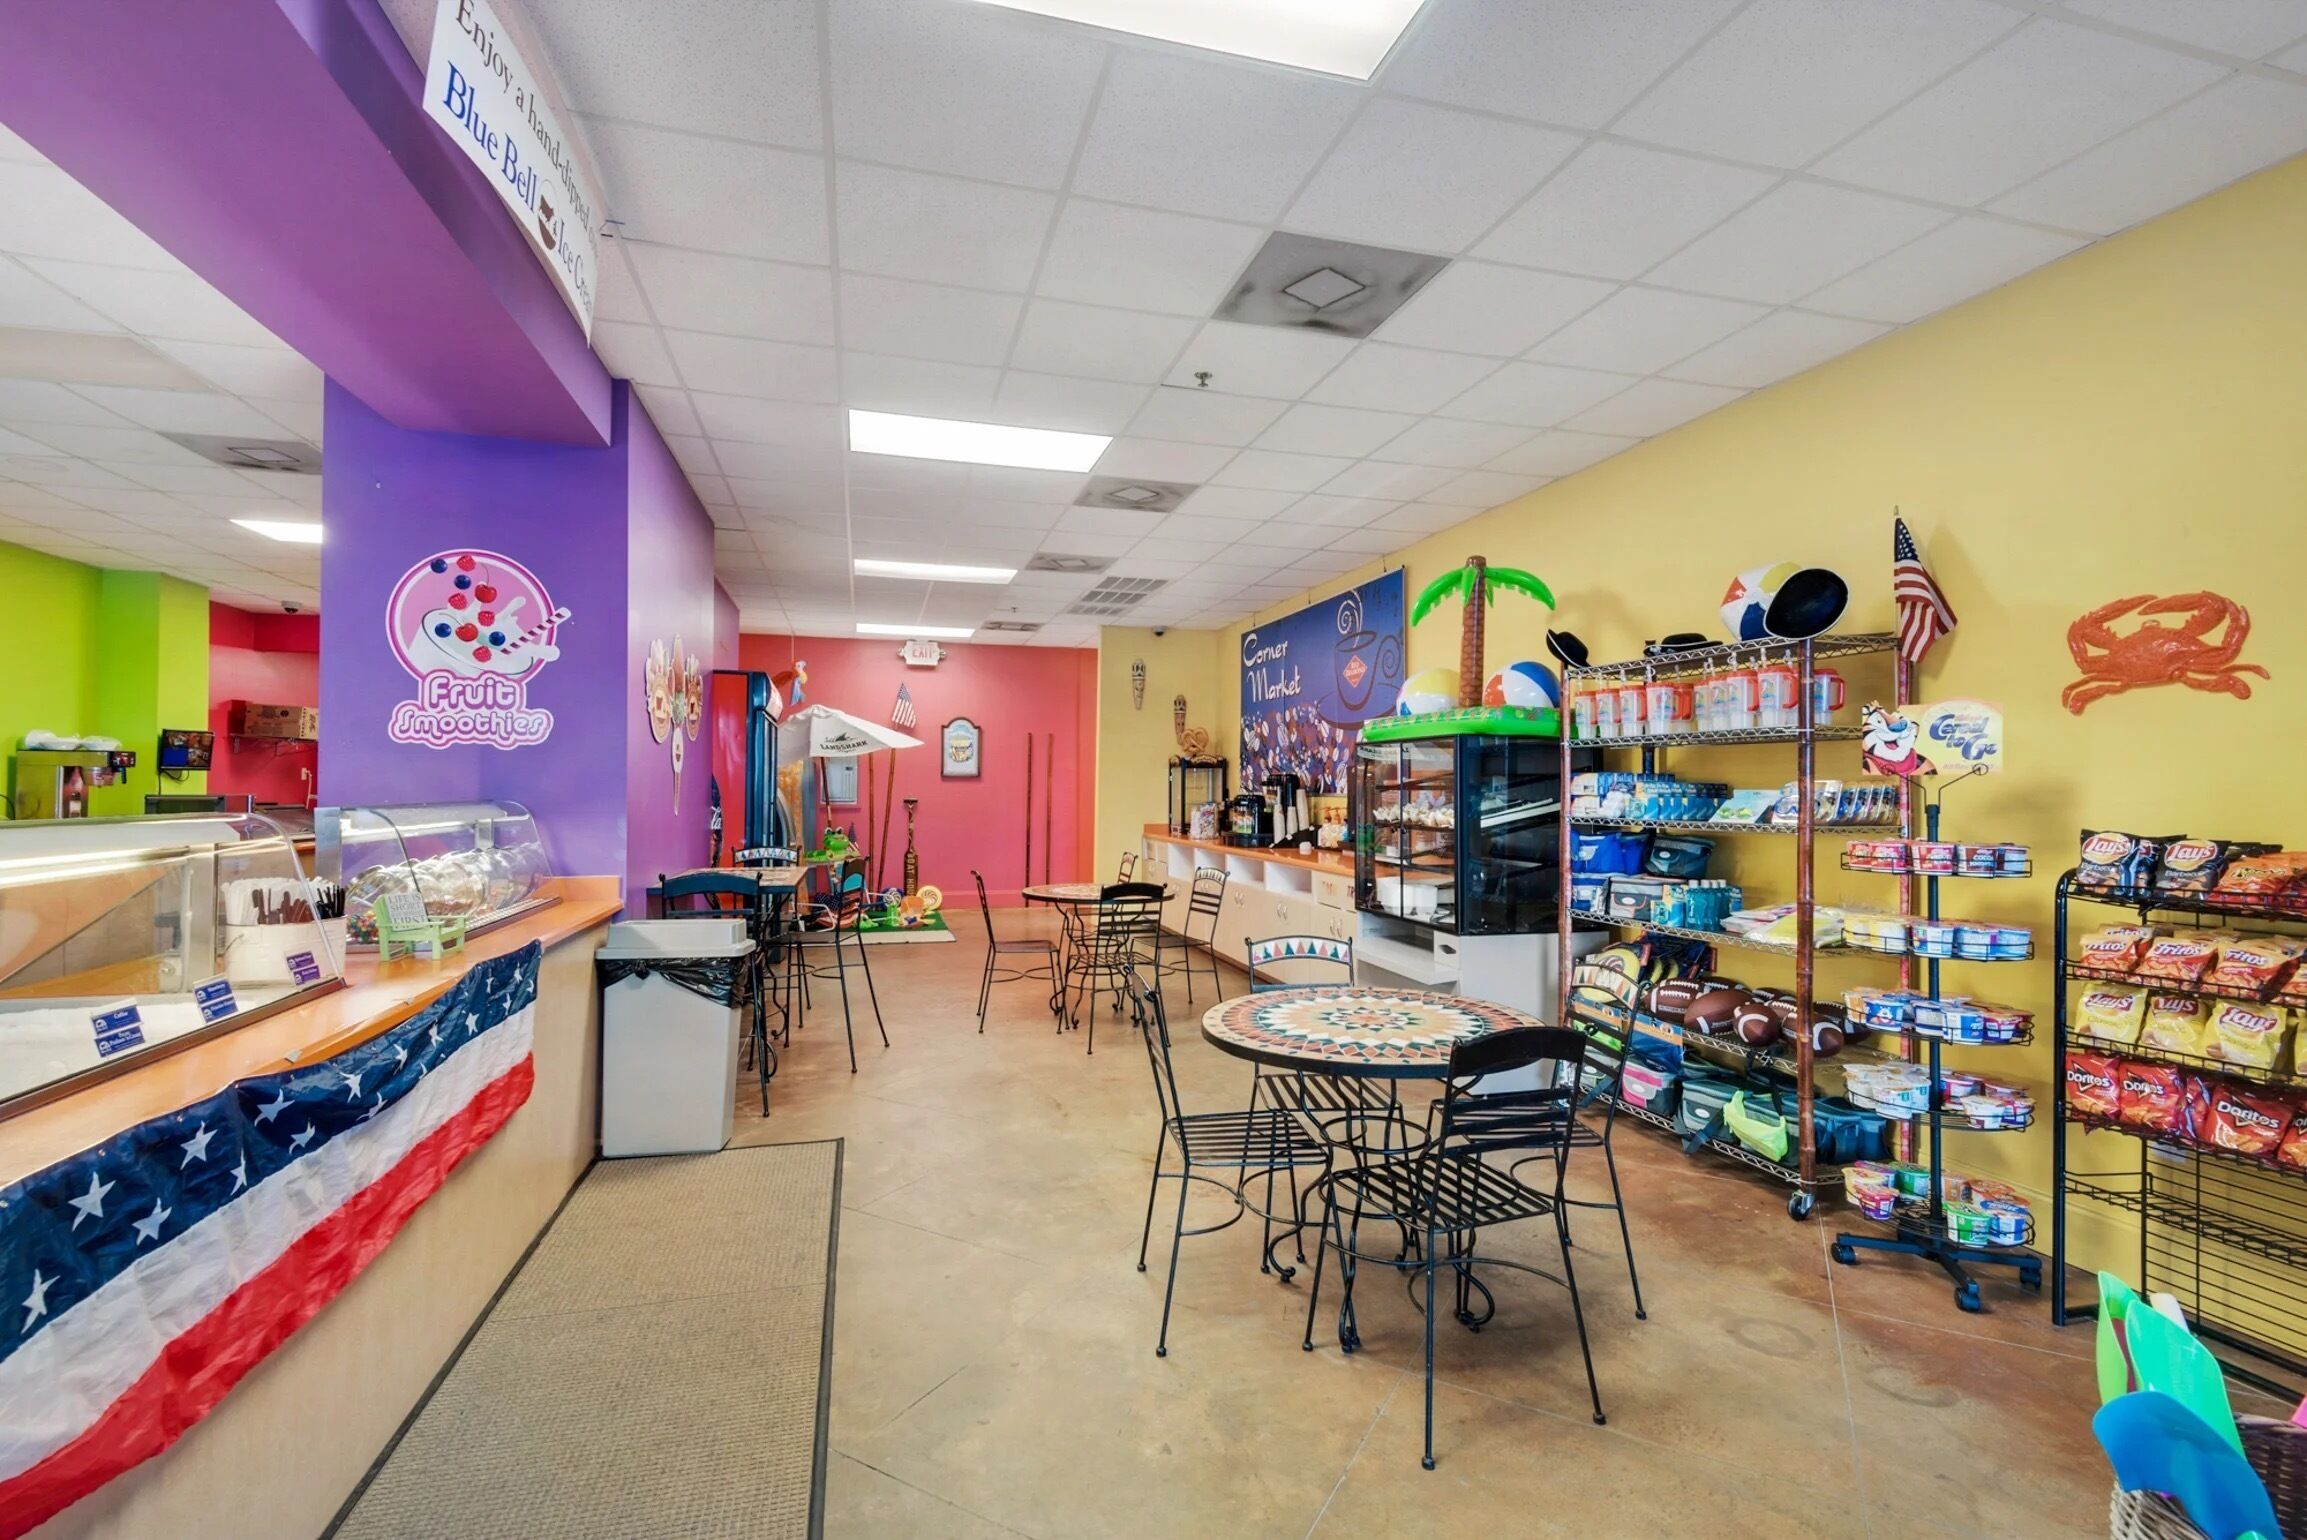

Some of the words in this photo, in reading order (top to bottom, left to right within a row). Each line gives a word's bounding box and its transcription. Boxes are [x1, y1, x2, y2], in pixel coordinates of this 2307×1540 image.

[455, 0, 513, 94] Enjoy
[516, 87, 524, 112] a
[528, 93, 590, 231] hand-dipped
[443, 60, 498, 161] Blue
[501, 131, 538, 214] Bell
[558, 218, 573, 273] Ice
[1243, 633, 1288, 667] Corner
[429, 676, 517, 709] Fruit
[1247, 665, 1301, 702] Market
[399, 709, 545, 740] Smoothies
[1929, 714, 1989, 741] Cereal
[820, 740, 868, 750] LANDSHARK
[1946, 734, 1965, 748] to
[1962, 734, 1998, 760] Go
[2084, 837, 2129, 854] Lay's
[2166, 842, 2214, 859] Lay's
[2066, 1070, 2110, 1087] Doritos
[2217, 1100, 2280, 1128] Doritos
